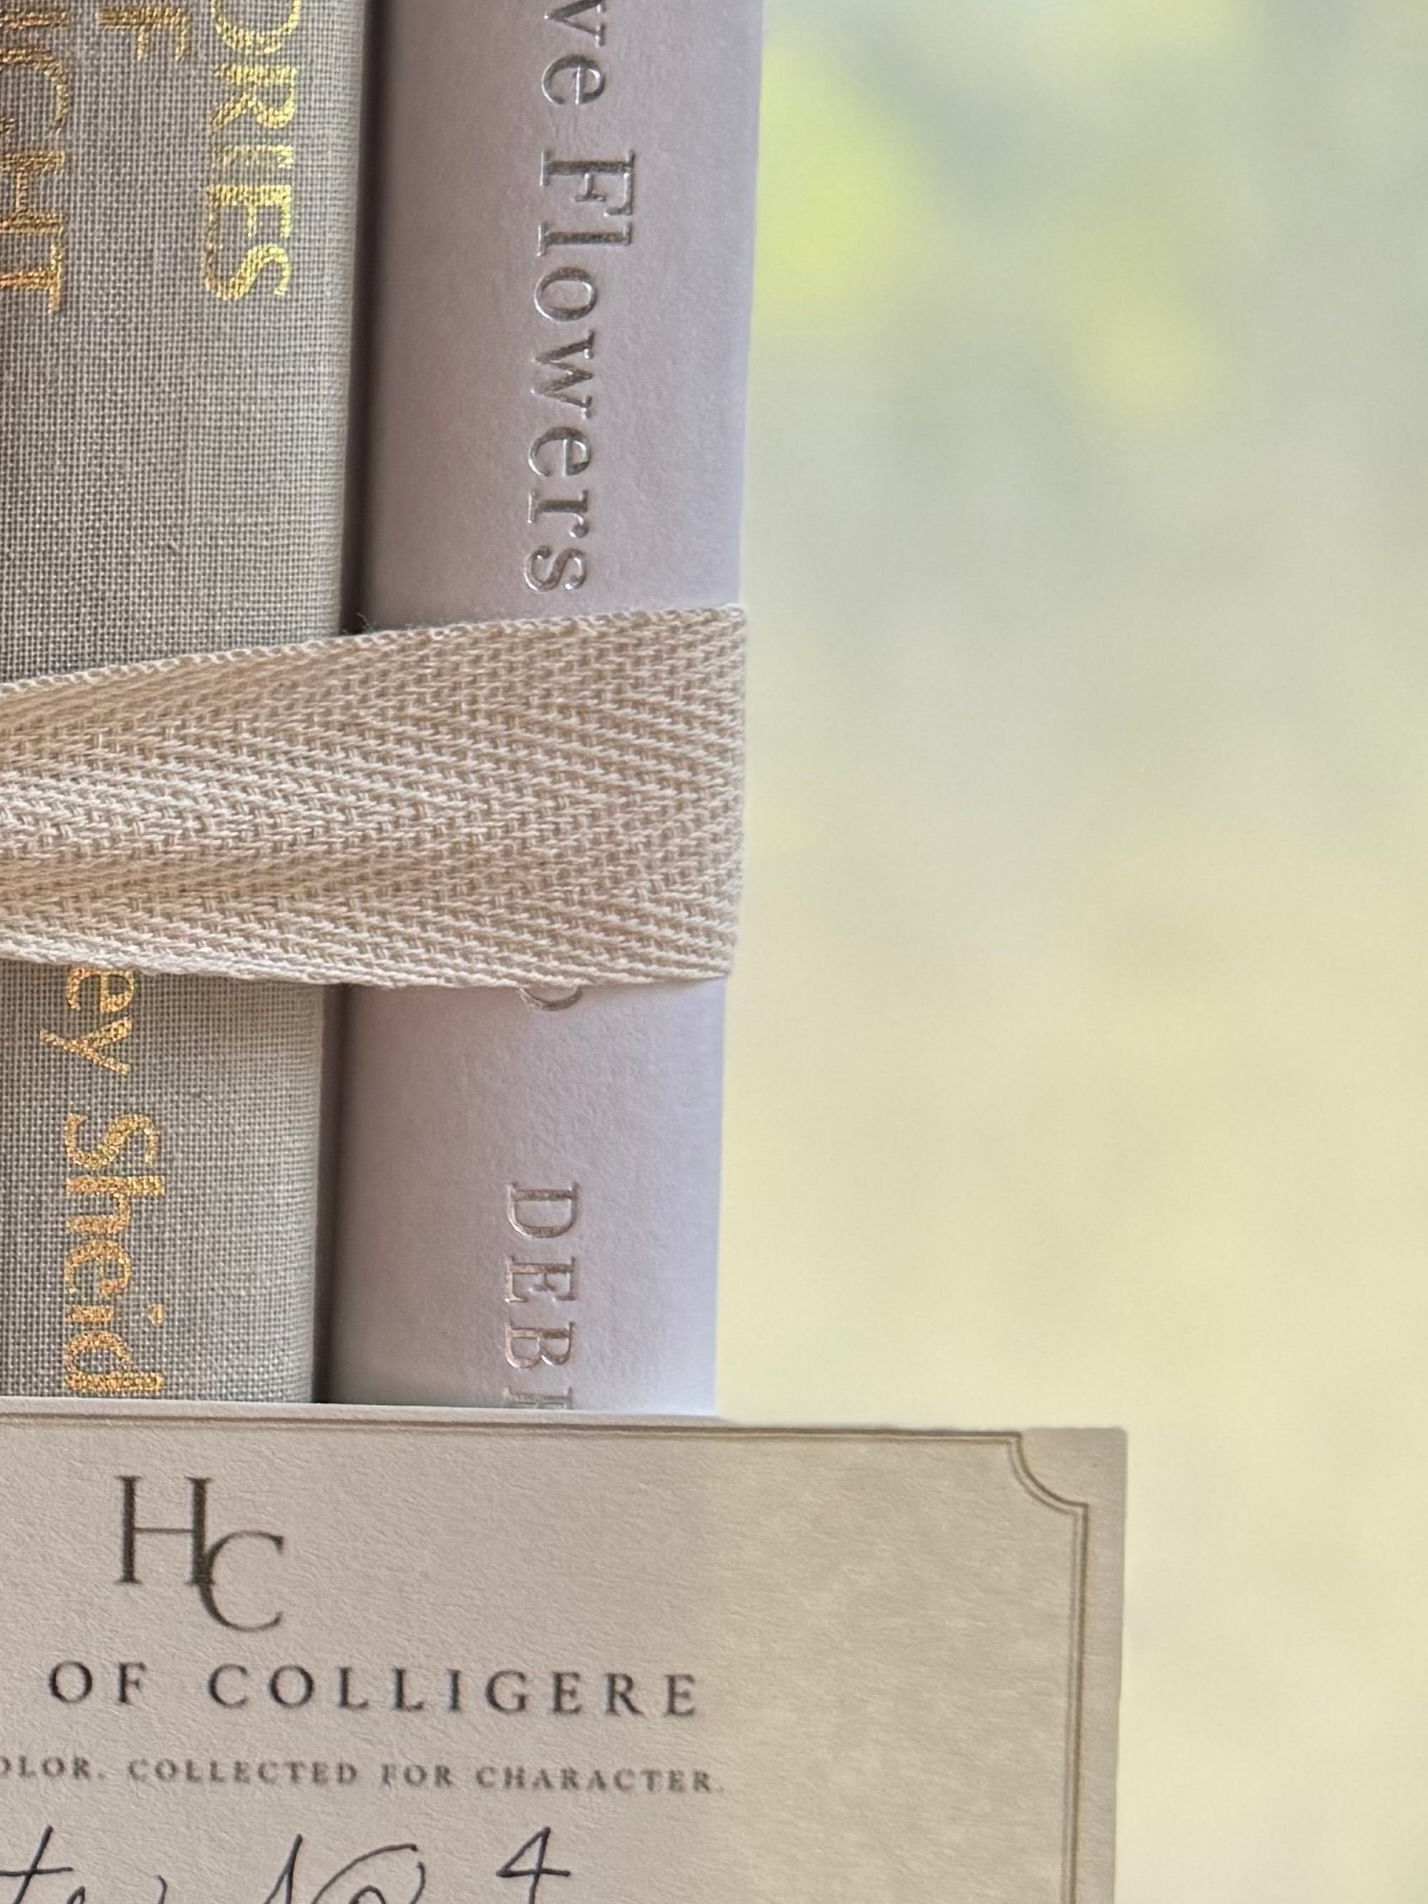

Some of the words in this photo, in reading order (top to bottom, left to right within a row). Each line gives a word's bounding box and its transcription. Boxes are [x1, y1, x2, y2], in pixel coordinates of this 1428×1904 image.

[522, 147, 636, 595] Flowers
[502, 1180, 582, 1410] DEB
[48, 1661, 147, 1705] OF
[207, 1664, 696, 1718] COLLIGERE
[127, 1758, 359, 1786] COLLECTED
[381, 1763, 454, 1788] FOR
